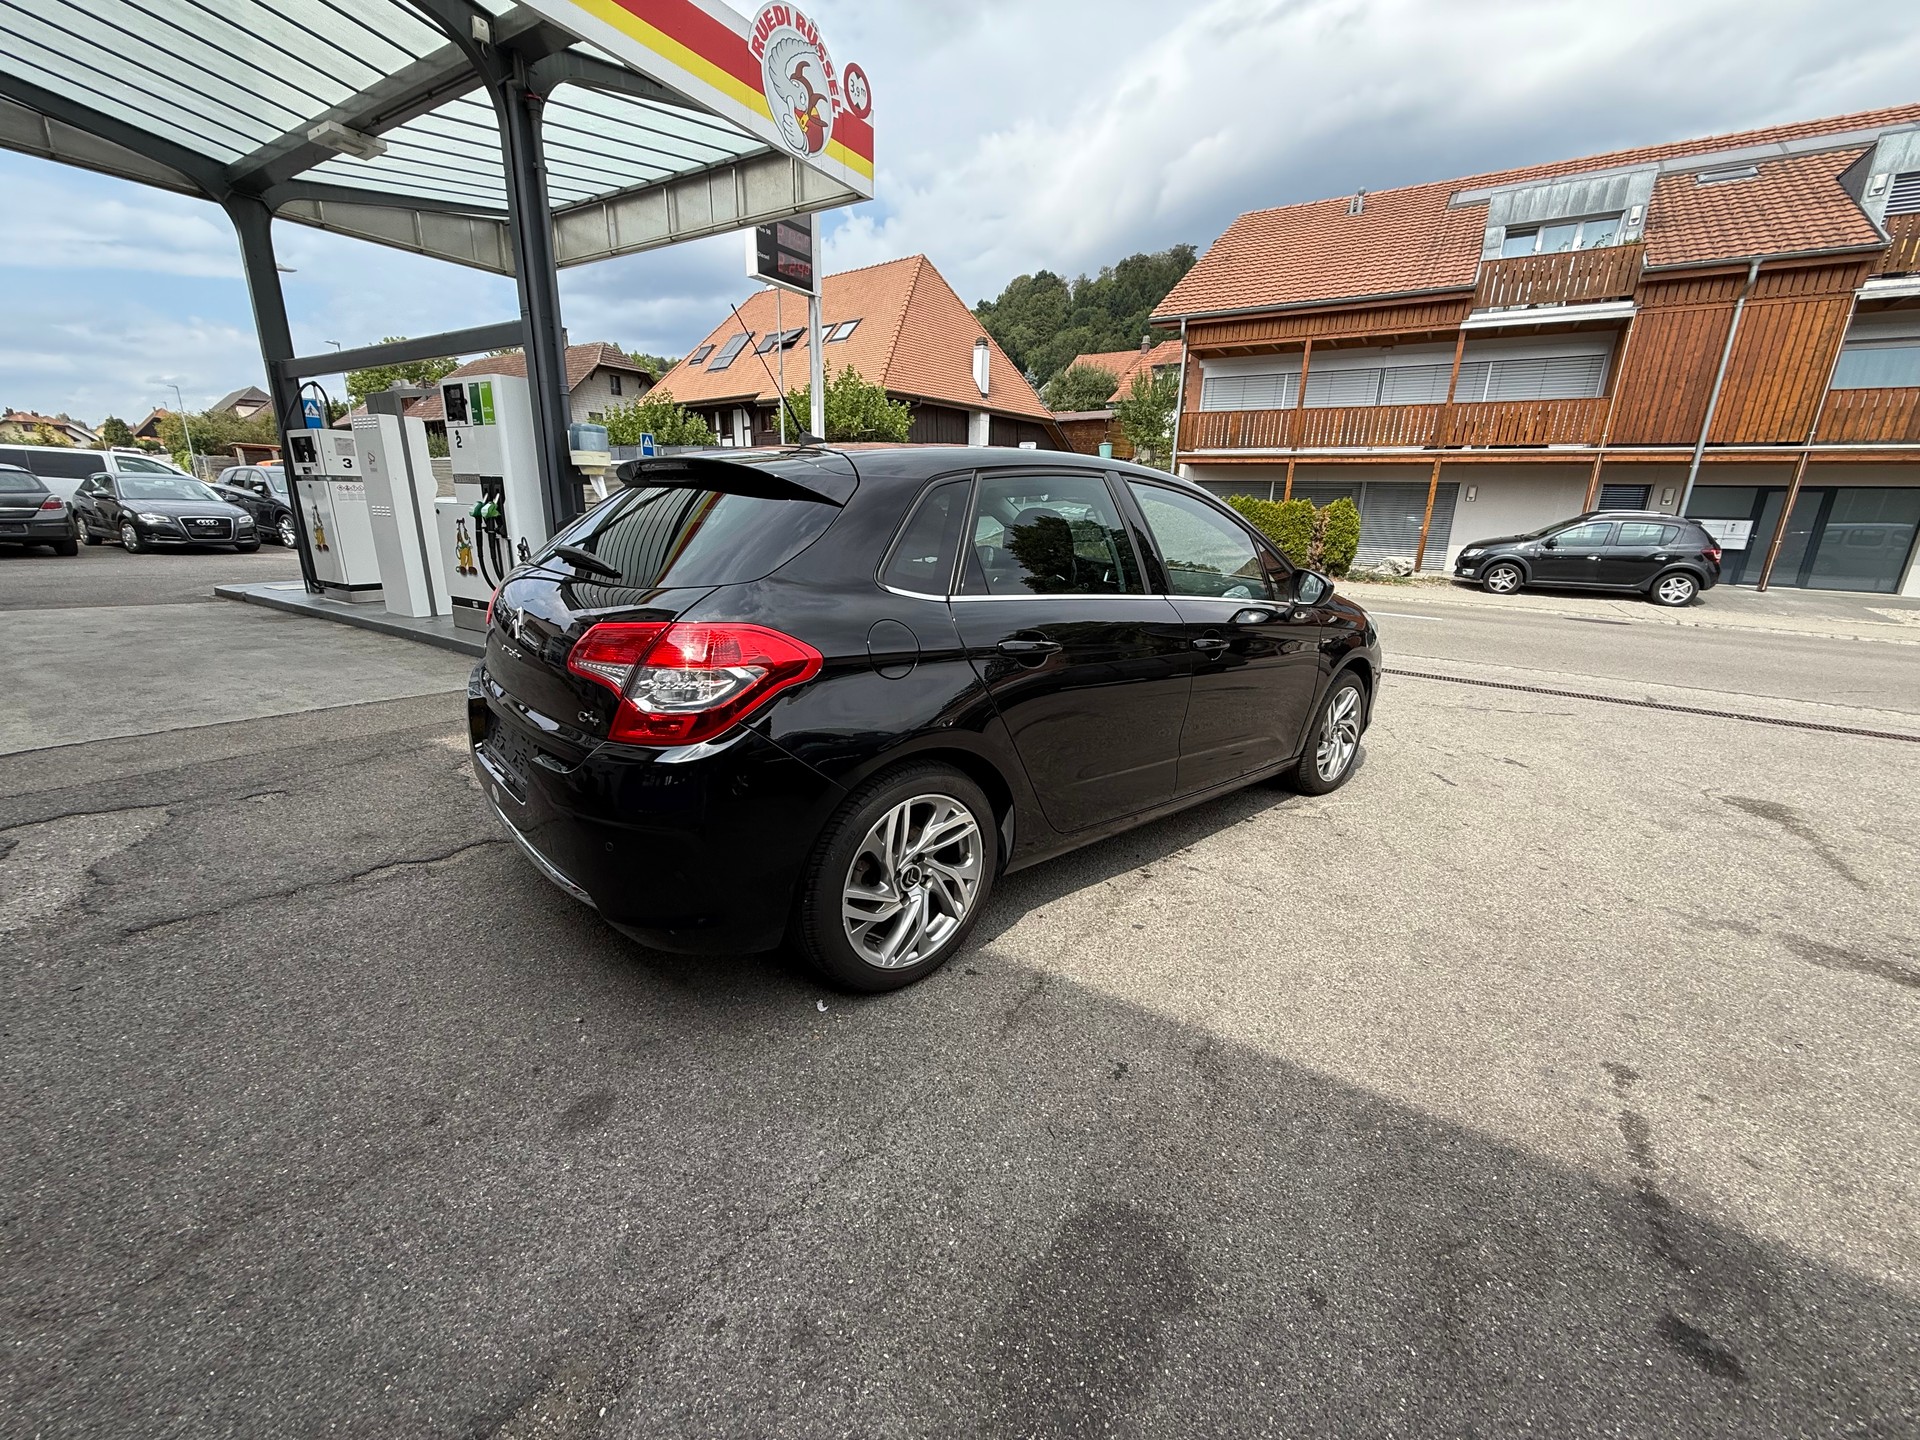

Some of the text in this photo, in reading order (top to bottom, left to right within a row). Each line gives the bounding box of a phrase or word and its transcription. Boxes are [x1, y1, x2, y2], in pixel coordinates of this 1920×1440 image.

[751, 4, 842, 114] RUEDI RÜSSEL
[456, 435, 463, 449] 2
[303, 451, 310, 463] 3
[342, 457, 353, 469] 3
